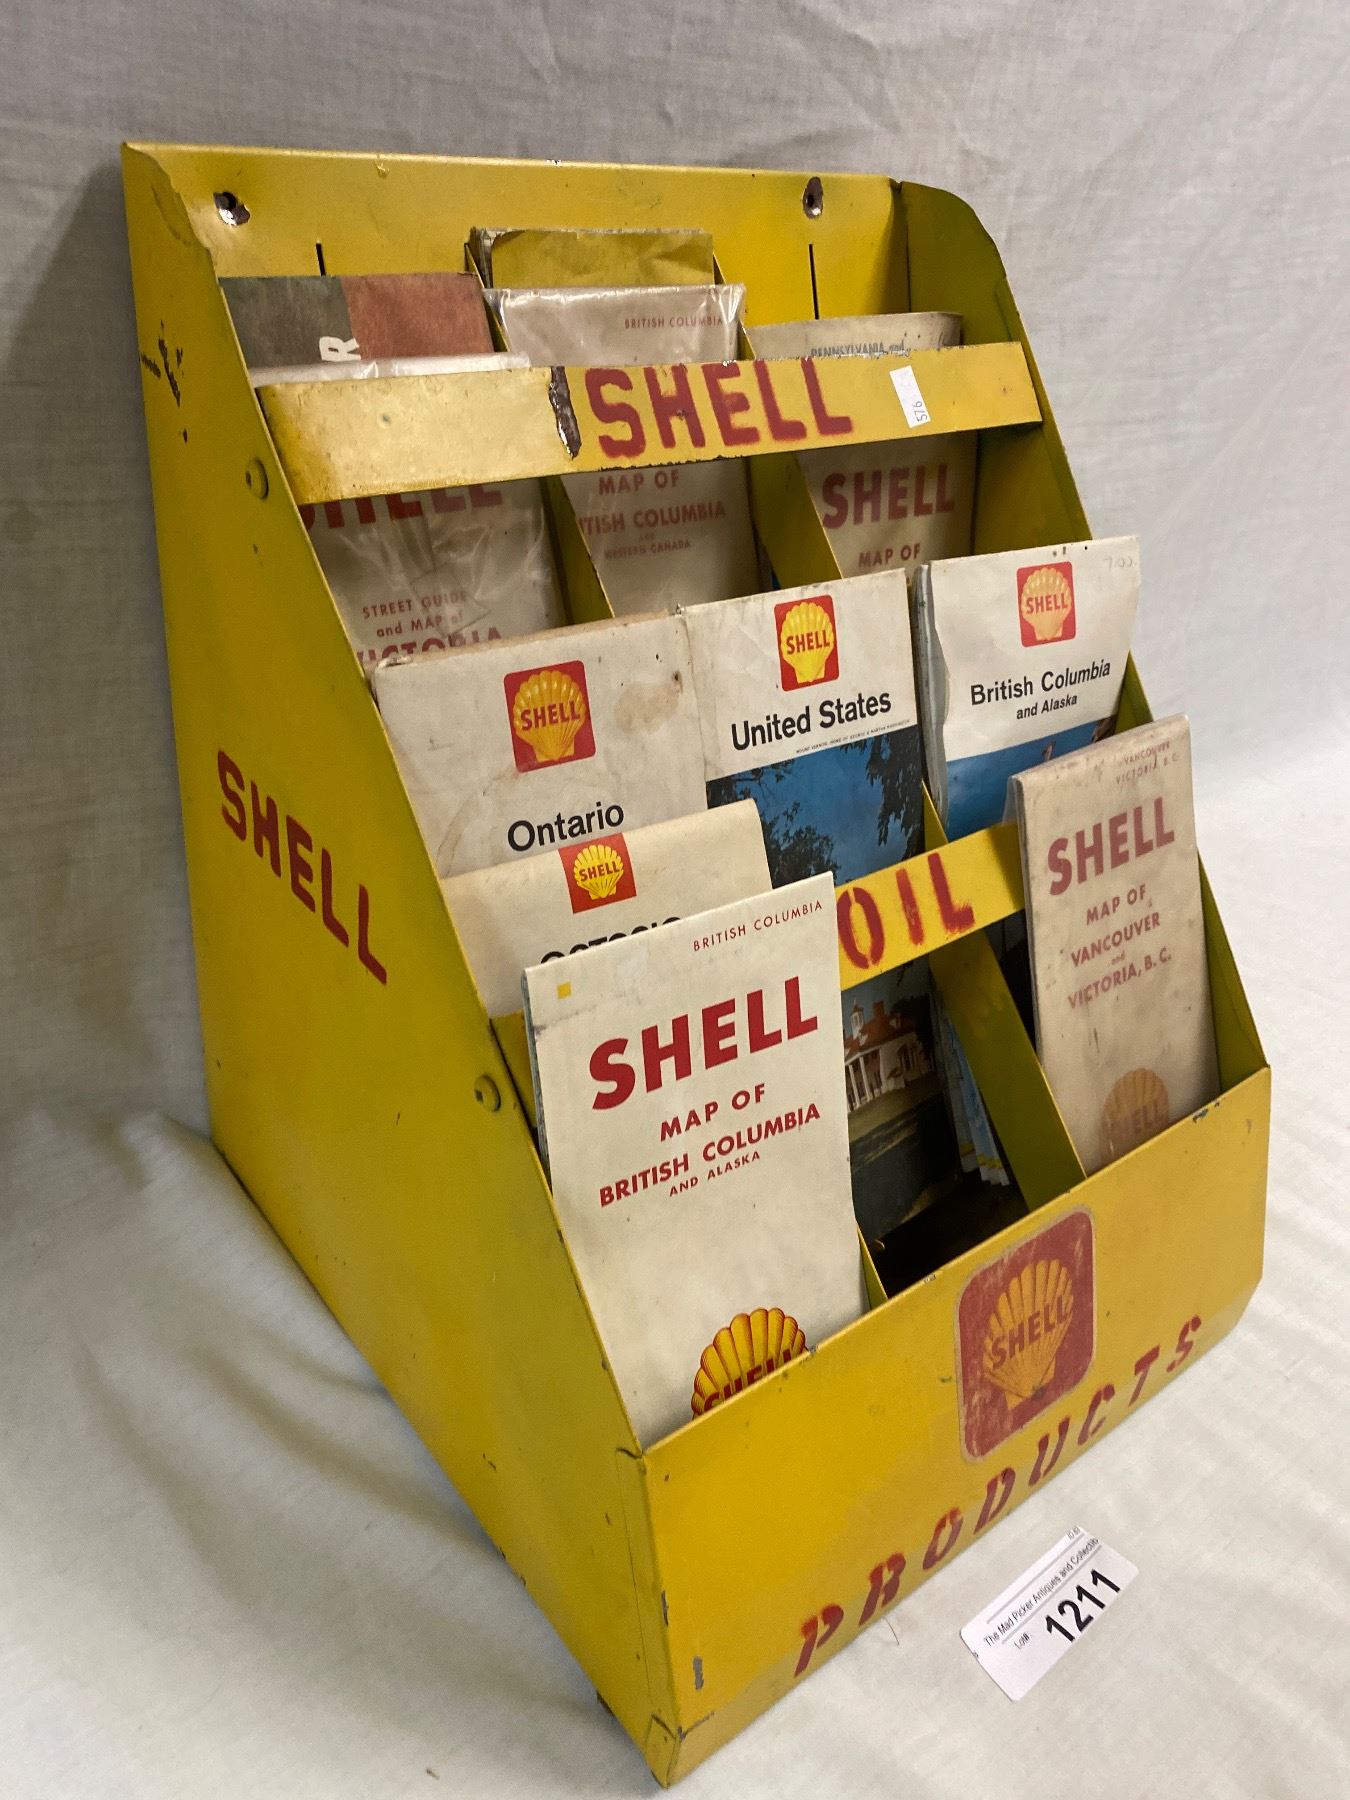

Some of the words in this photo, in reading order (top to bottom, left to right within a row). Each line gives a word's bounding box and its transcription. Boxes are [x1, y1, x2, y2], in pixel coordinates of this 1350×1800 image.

[624, 317, 665, 329] BRITISH
[669, 315, 723, 328] COLUMBIA
[584, 356, 852, 459] SHELL
[598, 473, 645, 496] MAP
[654, 469, 680, 489] OF
[822, 464, 955, 529] SHELL
[633, 501, 726, 528] COLUMBIA
[858, 548, 894, 569] MAP
[900, 543, 921, 561] OF
[362, 599, 413, 619] STREET
[376, 620, 403, 637] and
[411, 615, 442, 632] MAP
[1026, 592, 1068, 615] SHELL
[786, 629, 830, 655] SHELL
[970, 676, 1033, 706] British
[1041, 660, 1111, 692] Columbia
[1016, 703, 1038, 720] and
[1041, 694, 1078, 714] Alaska
[521, 700, 581, 731] SHELL
[731, 706, 811, 751] United
[819, 692, 892, 729] States
[507, 801, 625, 852] Ontario
[1048, 797, 1175, 896] SHELL
[217, 749, 387, 986] SHELL
[579, 861, 620, 882] SHELL
[693, 923, 746, 952] BRITISH
[753, 900, 823, 932] COLUMBIA
[837, 852, 975, 970] OIL
[1086, 896, 1120, 926] MAP
[1127, 883, 1146, 905] OF
[1070, 912, 1160, 968] VANCOUVER
[1067, 962, 1142, 1009] VICTORIA,
[1144, 955, 1157, 971] B.
[1160, 946, 1172, 963] C.
[589, 976, 818, 1111] SHELL
[660, 1100, 719, 1142] MAP
[731, 1083, 765, 1111] OF
[599, 1153, 689, 1208] BRITISH
[702, 1102, 820, 1163] COLUMBIA
[669, 1175, 699, 1197] AND
[707, 1150, 761, 1180] ALASKA
[991, 1296, 1069, 1370] SHELL
[794, 1315, 1202, 1678] PRODUCTS
[984, 1632, 1000, 1647] The
[997, 1616, 1015, 1635] Mad
[1012, 1599, 1034, 1621] Picker
[1032, 1575, 1062, 1604] Antiques
[1060, 1562, 1074, 1578] and
[1045, 1568, 1121, 1642] 1211
